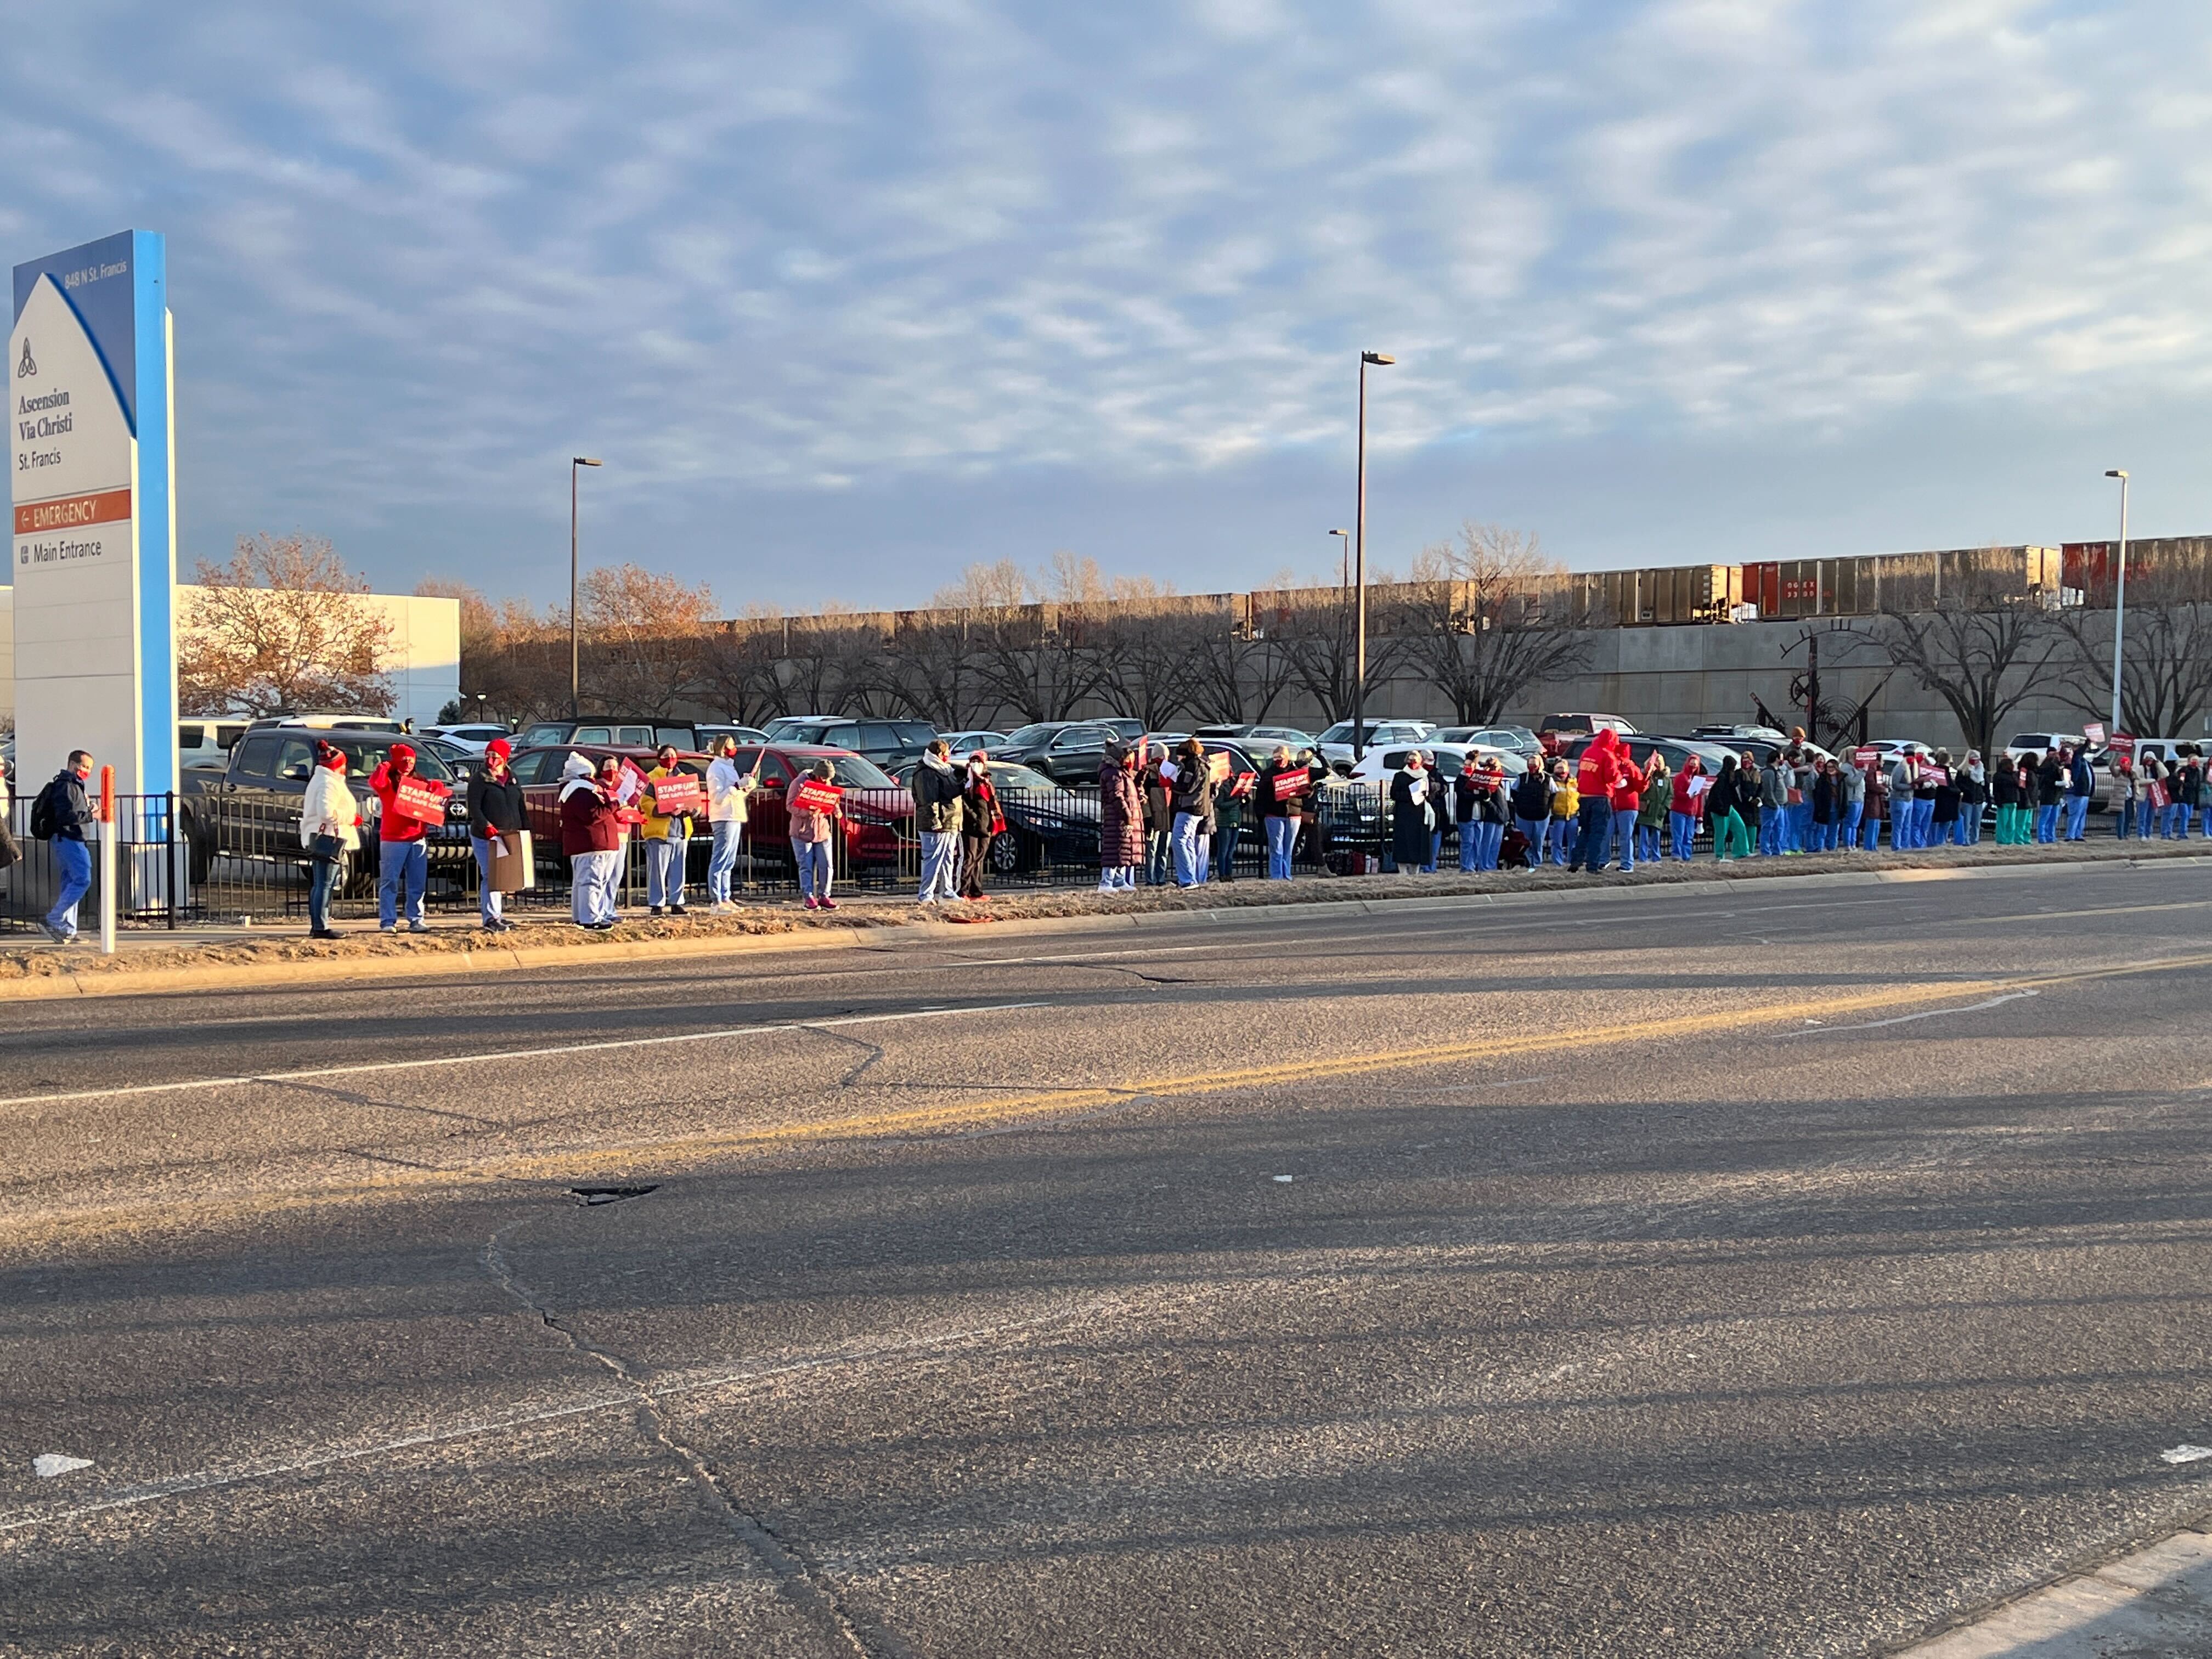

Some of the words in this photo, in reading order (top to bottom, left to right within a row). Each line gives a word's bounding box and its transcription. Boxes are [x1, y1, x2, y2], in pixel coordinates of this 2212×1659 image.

[64, 274, 80, 290] 848
[81, 269, 88, 285] N
[89, 266, 99, 282] St.
[100, 258, 127, 279] Francis
[18, 388, 69, 415] Ascension
[19, 420, 36, 441] Via
[37, 412, 72, 437] Christi
[19, 453, 30, 470] St.
[32, 447, 61, 468] Francis
[33, 500, 97, 528] EMERGENCY
[34, 542, 58, 563] Main
[60, 540, 101, 560] Entrance
[401, 785, 431, 800] STAFF
[657, 783, 683, 794] STAFF
[802, 786, 827, 798] STAFF
